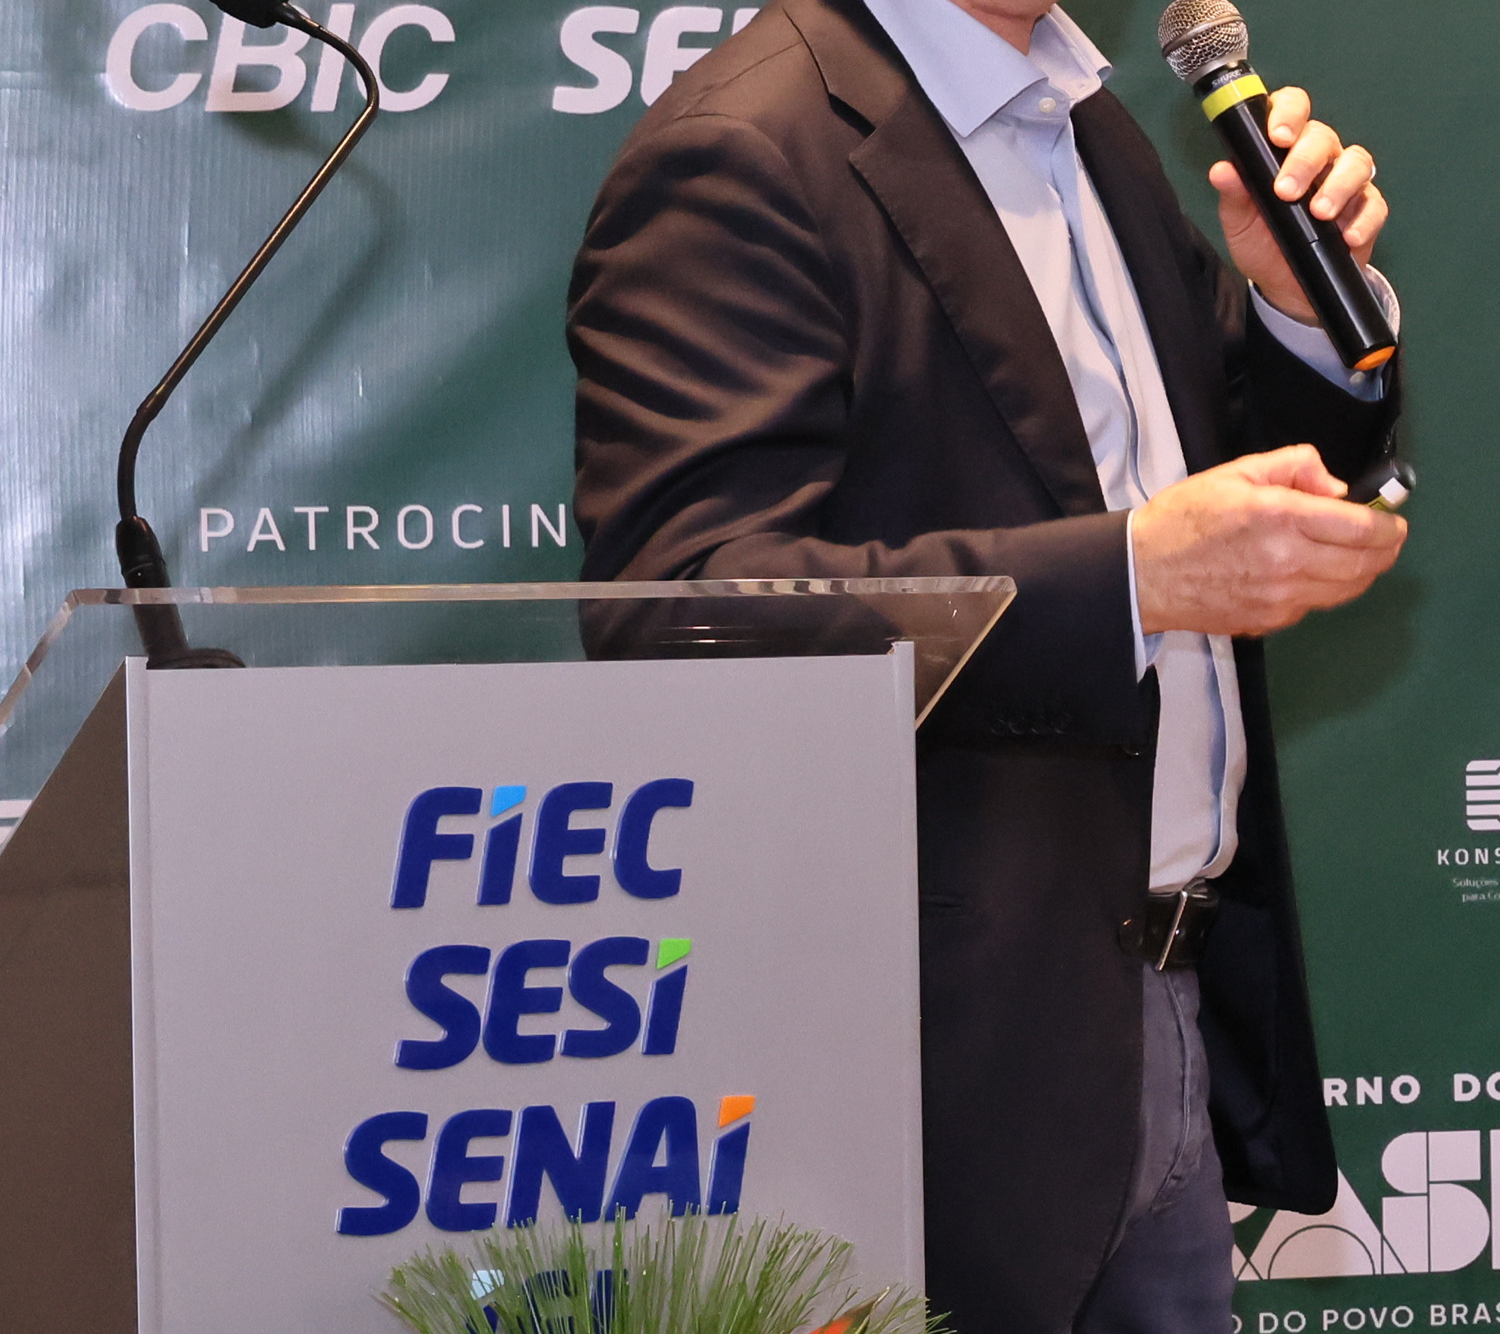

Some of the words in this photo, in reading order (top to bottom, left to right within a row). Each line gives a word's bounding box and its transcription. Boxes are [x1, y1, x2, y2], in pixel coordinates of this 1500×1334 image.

[103, 2, 456, 113] CBIC
[552, 5, 761, 115] SE
[1258, 1310, 1307, 1334] DO
[1322, 1305, 1414, 1332] POVO
